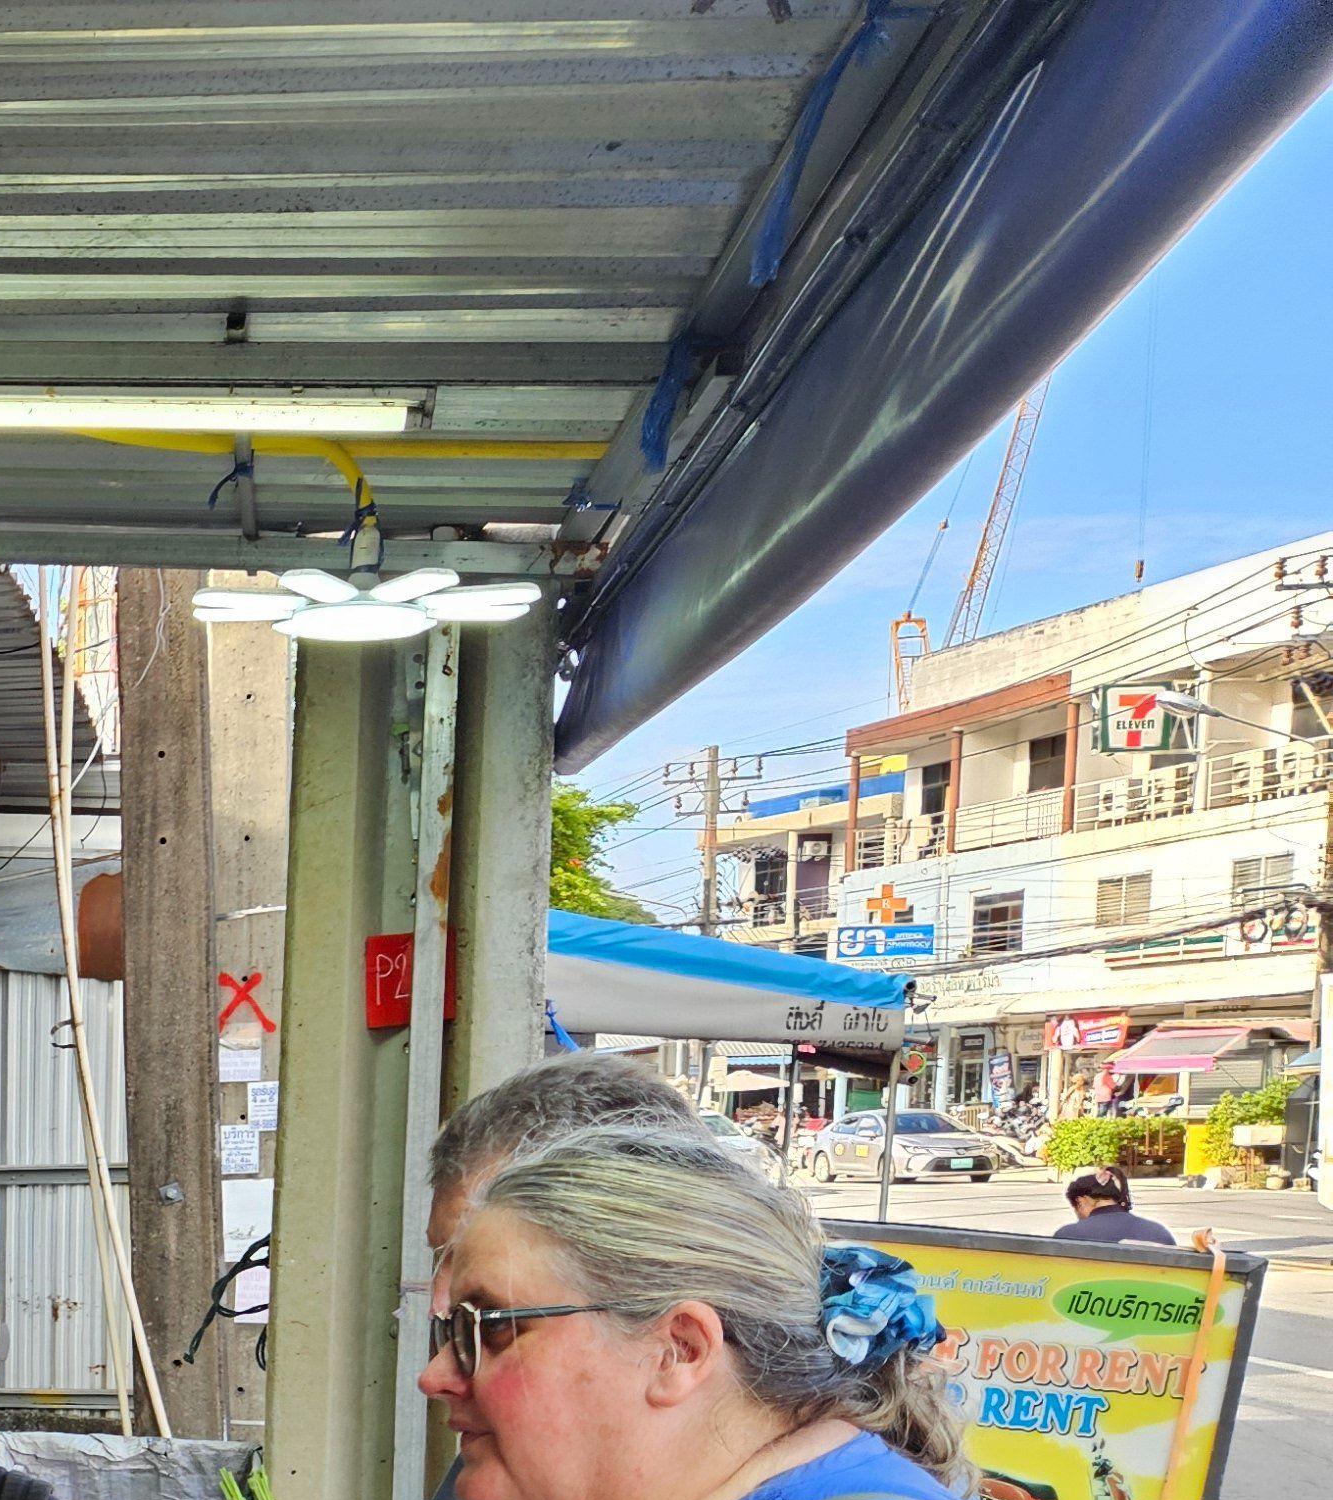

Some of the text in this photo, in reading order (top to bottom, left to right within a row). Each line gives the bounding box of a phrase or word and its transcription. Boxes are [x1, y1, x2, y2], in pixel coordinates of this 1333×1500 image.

[839, 929, 887, 956] ยา
[974, 1337, 1066, 1387] FOR
[979, 1386, 1109, 1438] RENT
